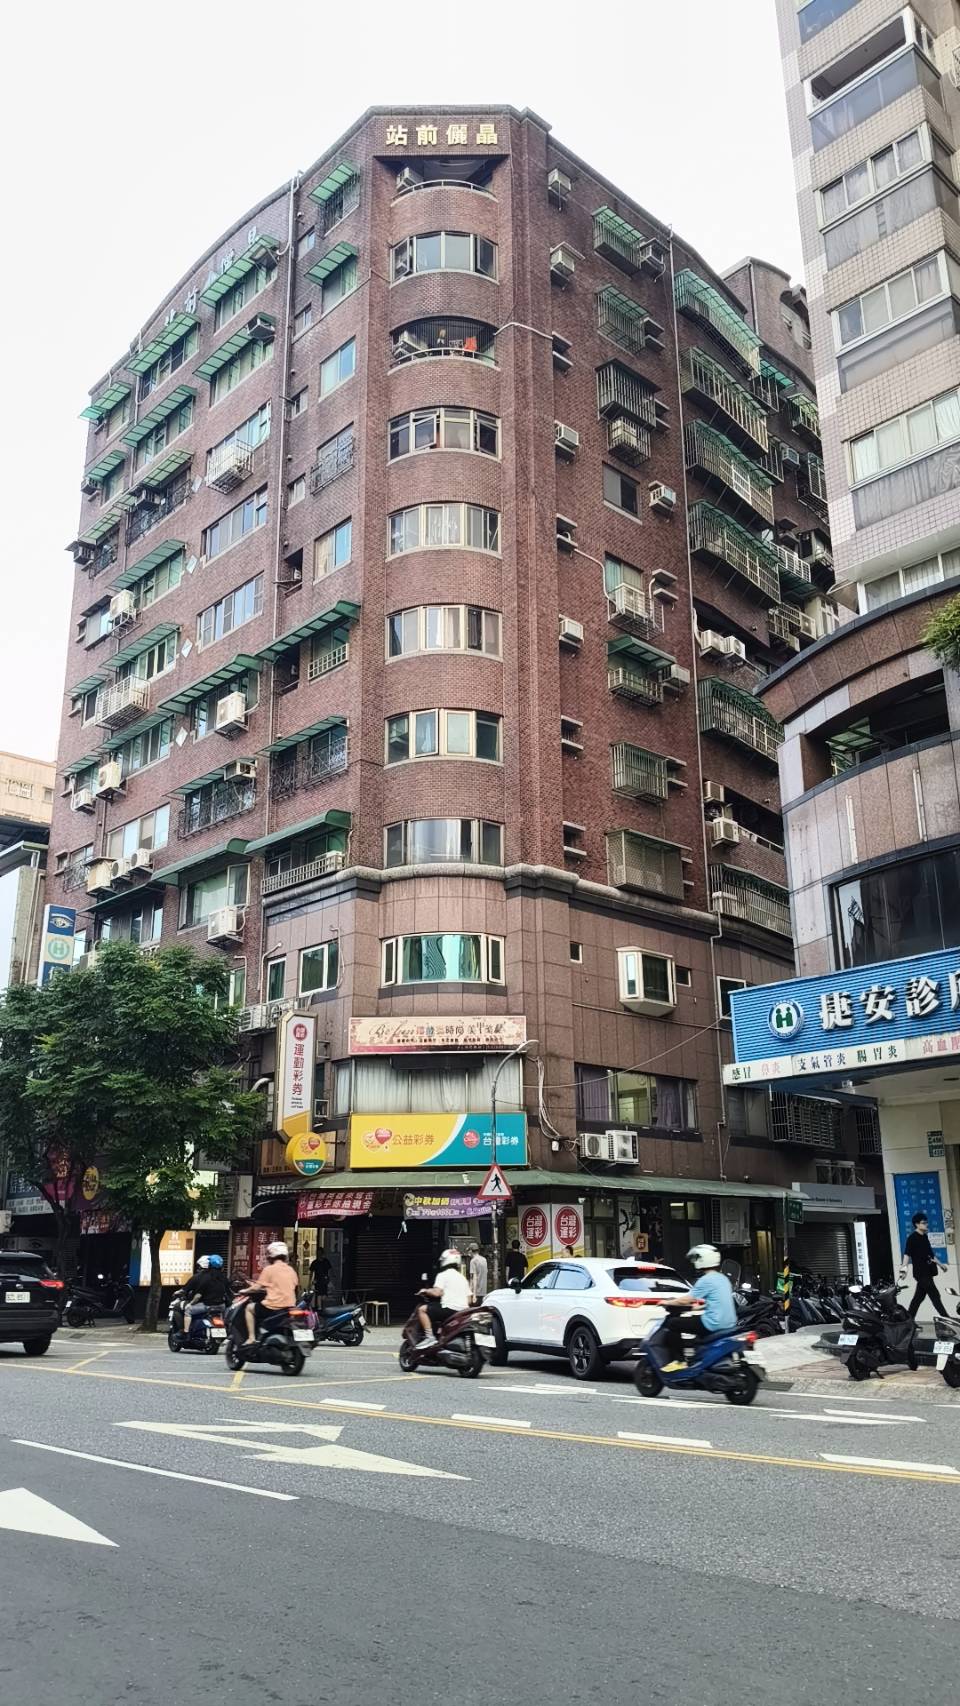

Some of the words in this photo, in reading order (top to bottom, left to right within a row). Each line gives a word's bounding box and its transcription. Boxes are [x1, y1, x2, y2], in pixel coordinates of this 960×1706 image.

[386, 124, 498, 146] 站前儷晶
[819, 970, 960, 1032] 捷安診
[291, 1043, 305, 1096] 運動彩券
[798, 1052, 846, 1072] 支氣管炎
[856, 1044, 898, 1064] 腸胃炎
[392, 1133, 435, 1146] 公益彩券
